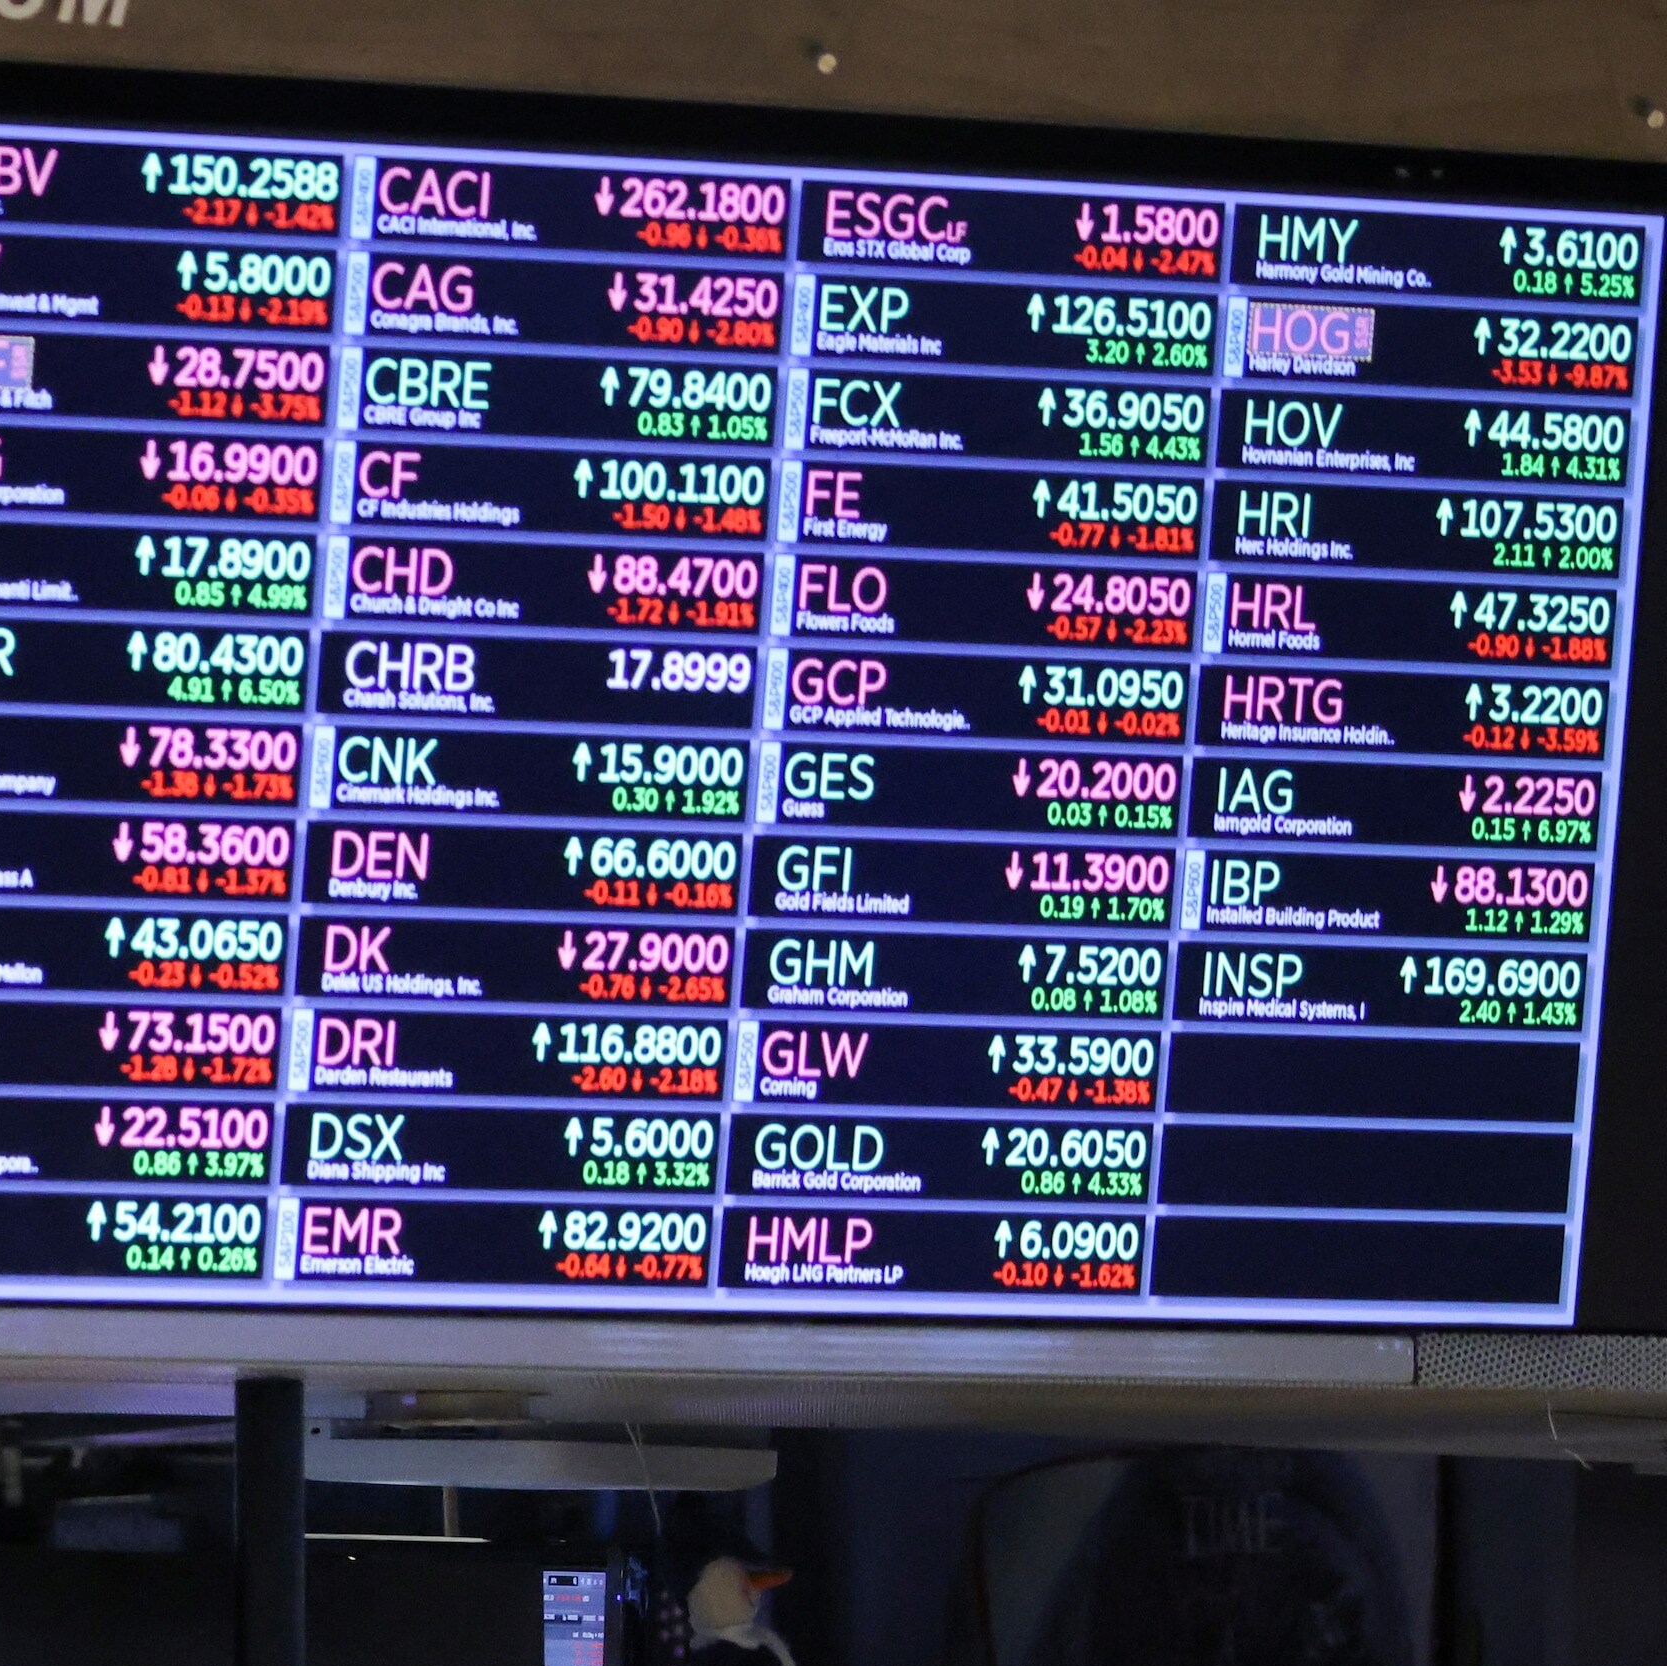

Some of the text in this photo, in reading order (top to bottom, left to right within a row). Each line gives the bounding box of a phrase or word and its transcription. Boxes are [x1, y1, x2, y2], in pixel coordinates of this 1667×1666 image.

[1258, 214, 1359, 264] HMY
[1523, 227, 1639, 271] 3.6100
[1320, 264, 1355, 284] Gold
[1252, 308, 1350, 355] HOG
[1498, 319, 1632, 361] 32.2200
[365, 357, 492, 409] CBRE
[1487, 409, 1625, 453] 44.5800
[1460, 499, 1618, 543] 107.5300
[1473, 592, 1611, 634] 47.3250
[345, 640, 475, 693] CHRB
[782, 799, 825, 818] Guess
[1217, 767, 1293, 814] IAG
[1274, 816, 1353, 837] Corporation
[774, 892, 909, 914] Gold Fields Limited
[1209, 859, 1281, 906] IBP
[130, 917, 283, 962] 43.0650
[1265, 907, 1325, 930] Building
[1327, 909, 1380, 929] Product
[1202, 951, 1303, 999] INSP
[827, 987, 908, 1008] Corporation
[762, 1030, 869, 1078] GLW
[1012, 1034, 1155, 1077] 33.5900
[1008, 1077, 1063, 1102] -0.47
[754, 1123, 884, 1172] GOLD
[1005, 1127, 1147, 1168] 20.6050
[752, 1170, 921, 1193] Barrick Gold Corporation
[1021, 1170, 1142, 1196] 0.86 4.33%
[747, 1215, 873, 1263] HMLP
[1020, 1220, 1139, 1260] 6.0900
[792, 1264, 823, 1282] LNG
[826, 1265, 882, 1284] Partners
[884, 1266, 903, 1284] LP
[993, 1261, 1048, 1286] -0.10
